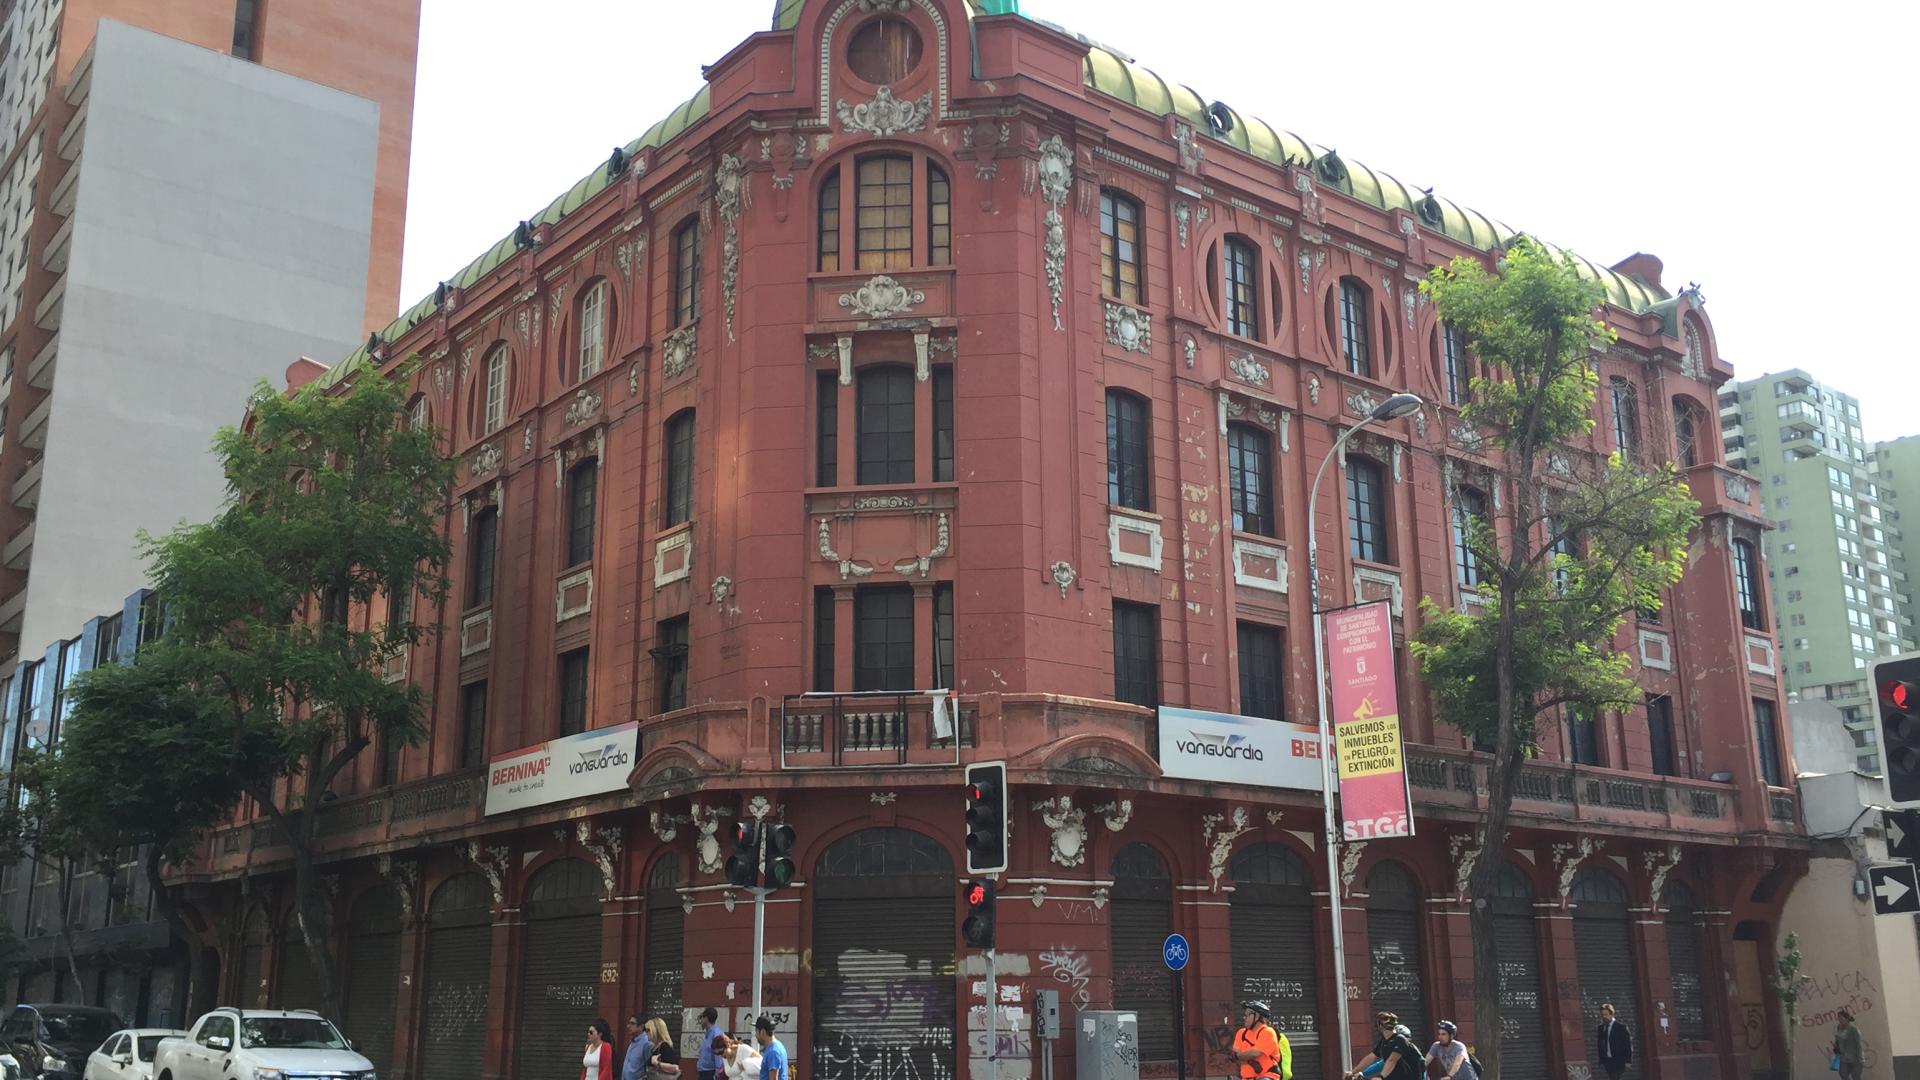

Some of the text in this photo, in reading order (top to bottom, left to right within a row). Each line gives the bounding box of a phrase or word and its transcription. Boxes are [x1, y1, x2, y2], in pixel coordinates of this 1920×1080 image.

[1340, 721, 1385, 737] SALVEMOS
[1344, 732, 1393, 749] INMUEBLES
[1176, 740, 1264, 761] vanguardia
[1351, 745, 1389, 760] PELIGRO
[569, 751, 628, 775] vanguardia
[1348, 755, 1394, 773] EXTINCIÓN
[492, 759, 545, 786] BERNINA
[602, 969, 616, 983] 692
[1243, 977, 1304, 999] ESTAMOS
